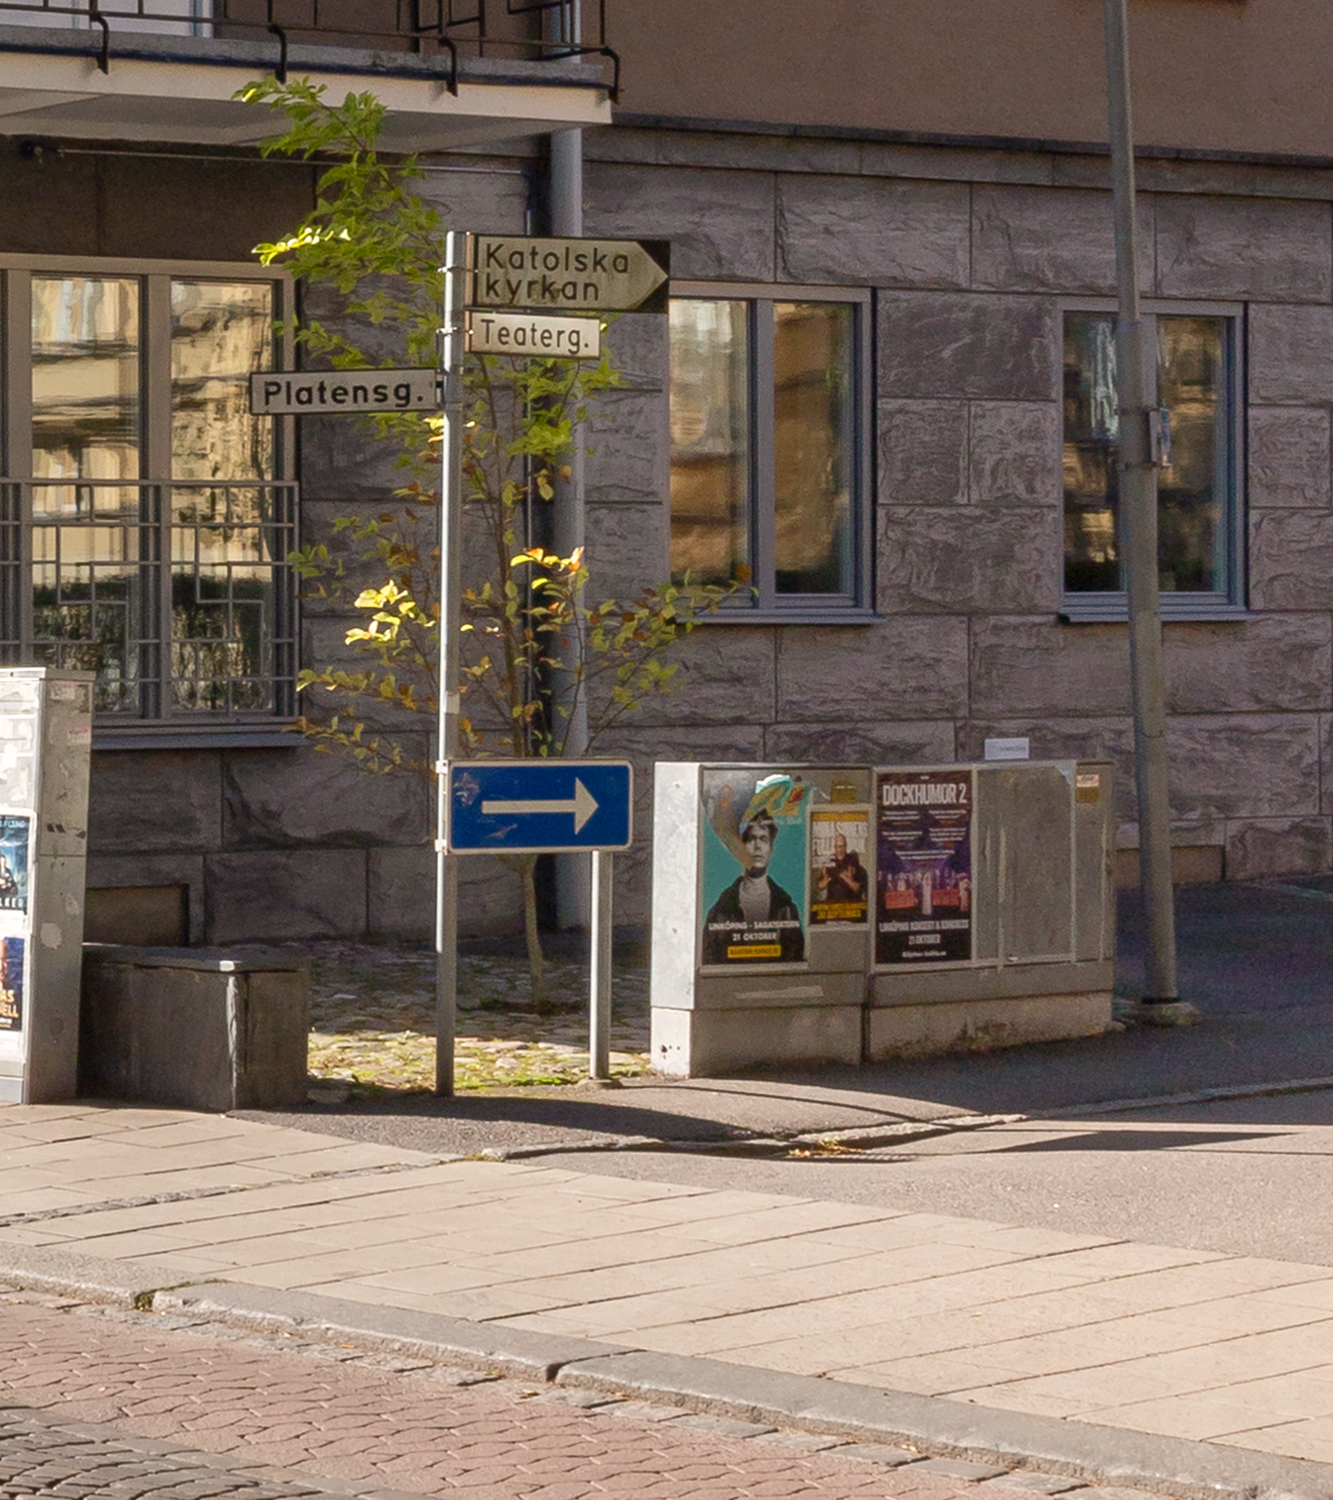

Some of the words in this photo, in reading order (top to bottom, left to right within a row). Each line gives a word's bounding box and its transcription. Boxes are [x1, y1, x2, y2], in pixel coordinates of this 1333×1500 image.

[485, 243, 629, 273] Katolska
[485, 273, 599, 304] kyrkan
[480, 318, 589, 354] Teaterg.
[264, 380, 424, 408] Platensg.
[882, 783, 957, 806] DOCKHUMOR
[959, 782, 968, 804] 2
[708, 920, 748, 931] LINKÖPING
[742, 932, 778, 941] OKTOBER
